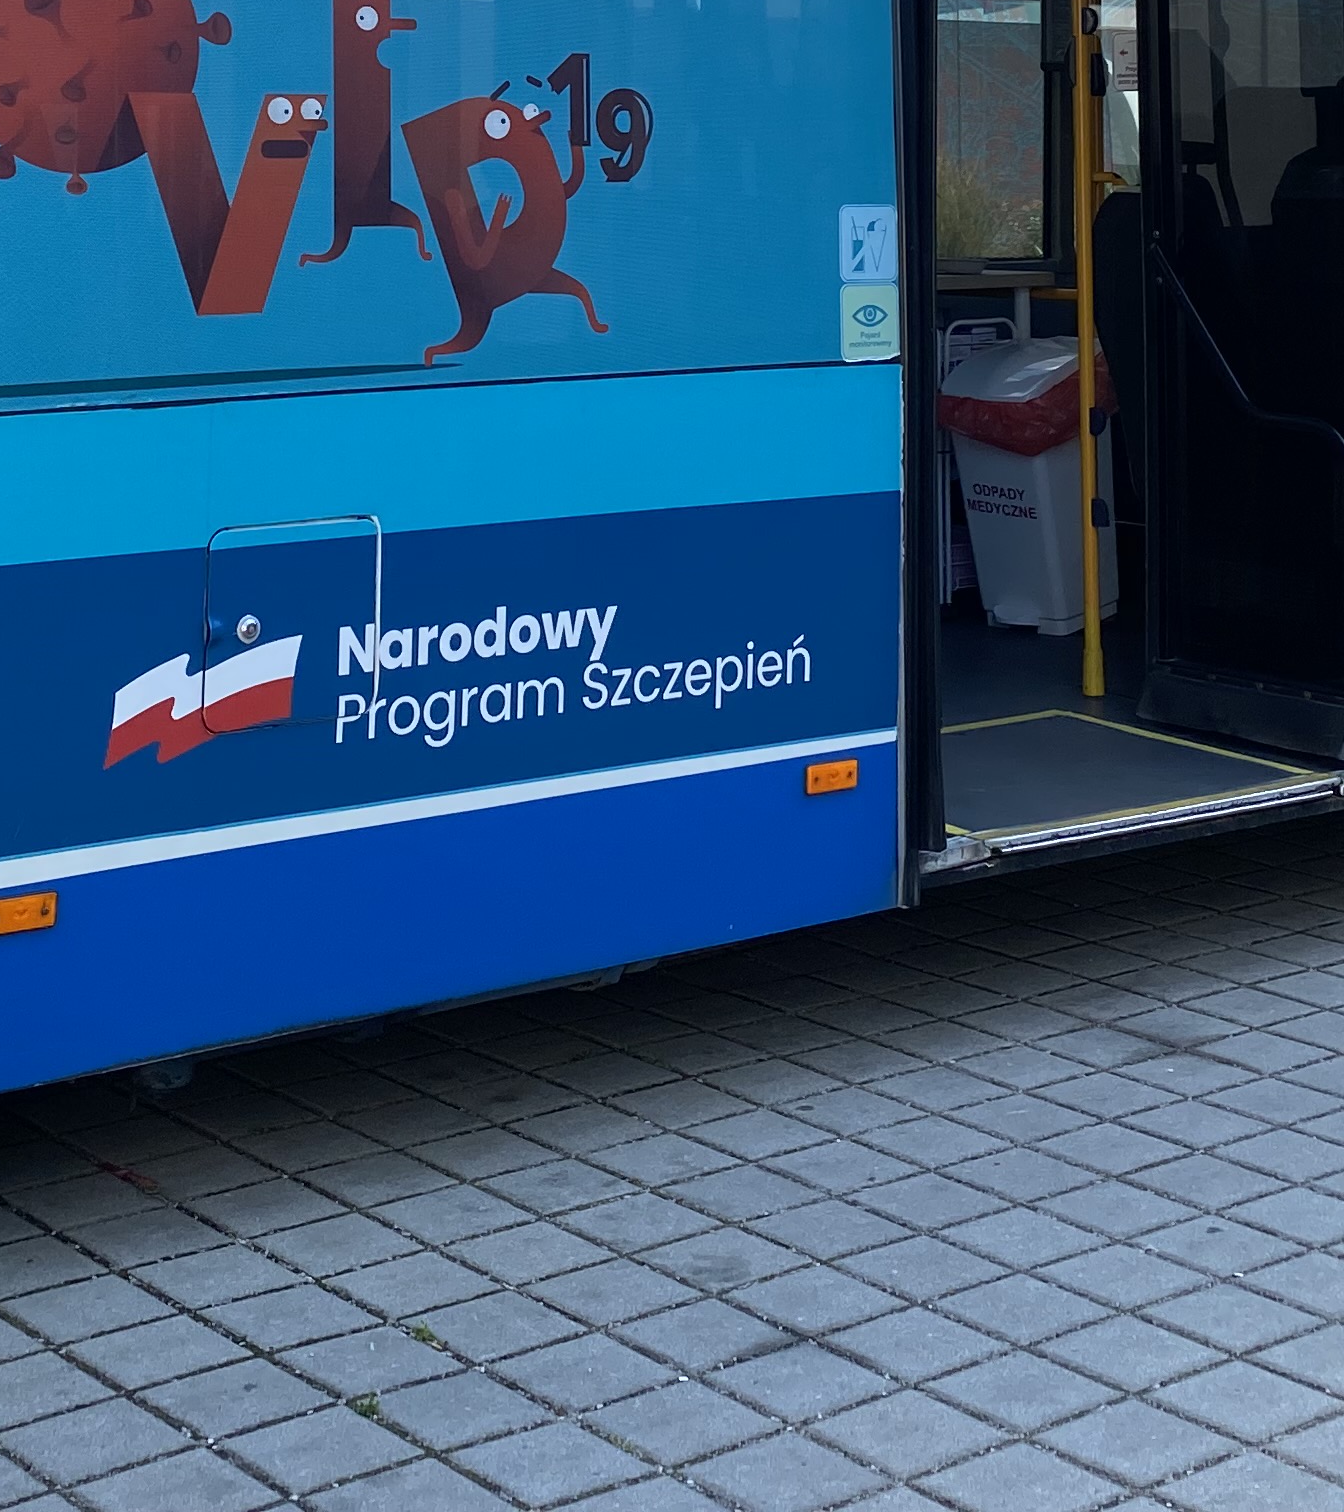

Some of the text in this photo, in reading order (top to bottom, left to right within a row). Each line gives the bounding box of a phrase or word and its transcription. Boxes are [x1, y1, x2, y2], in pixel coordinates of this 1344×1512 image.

[548, 52, 654, 183] 19
[967, 498, 1038, 520] MEDYCZNE
[972, 483, 1025, 502] ODPADY
[337, 605, 618, 676] Narodowy
[336, 634, 812, 748] Program Szczepień
